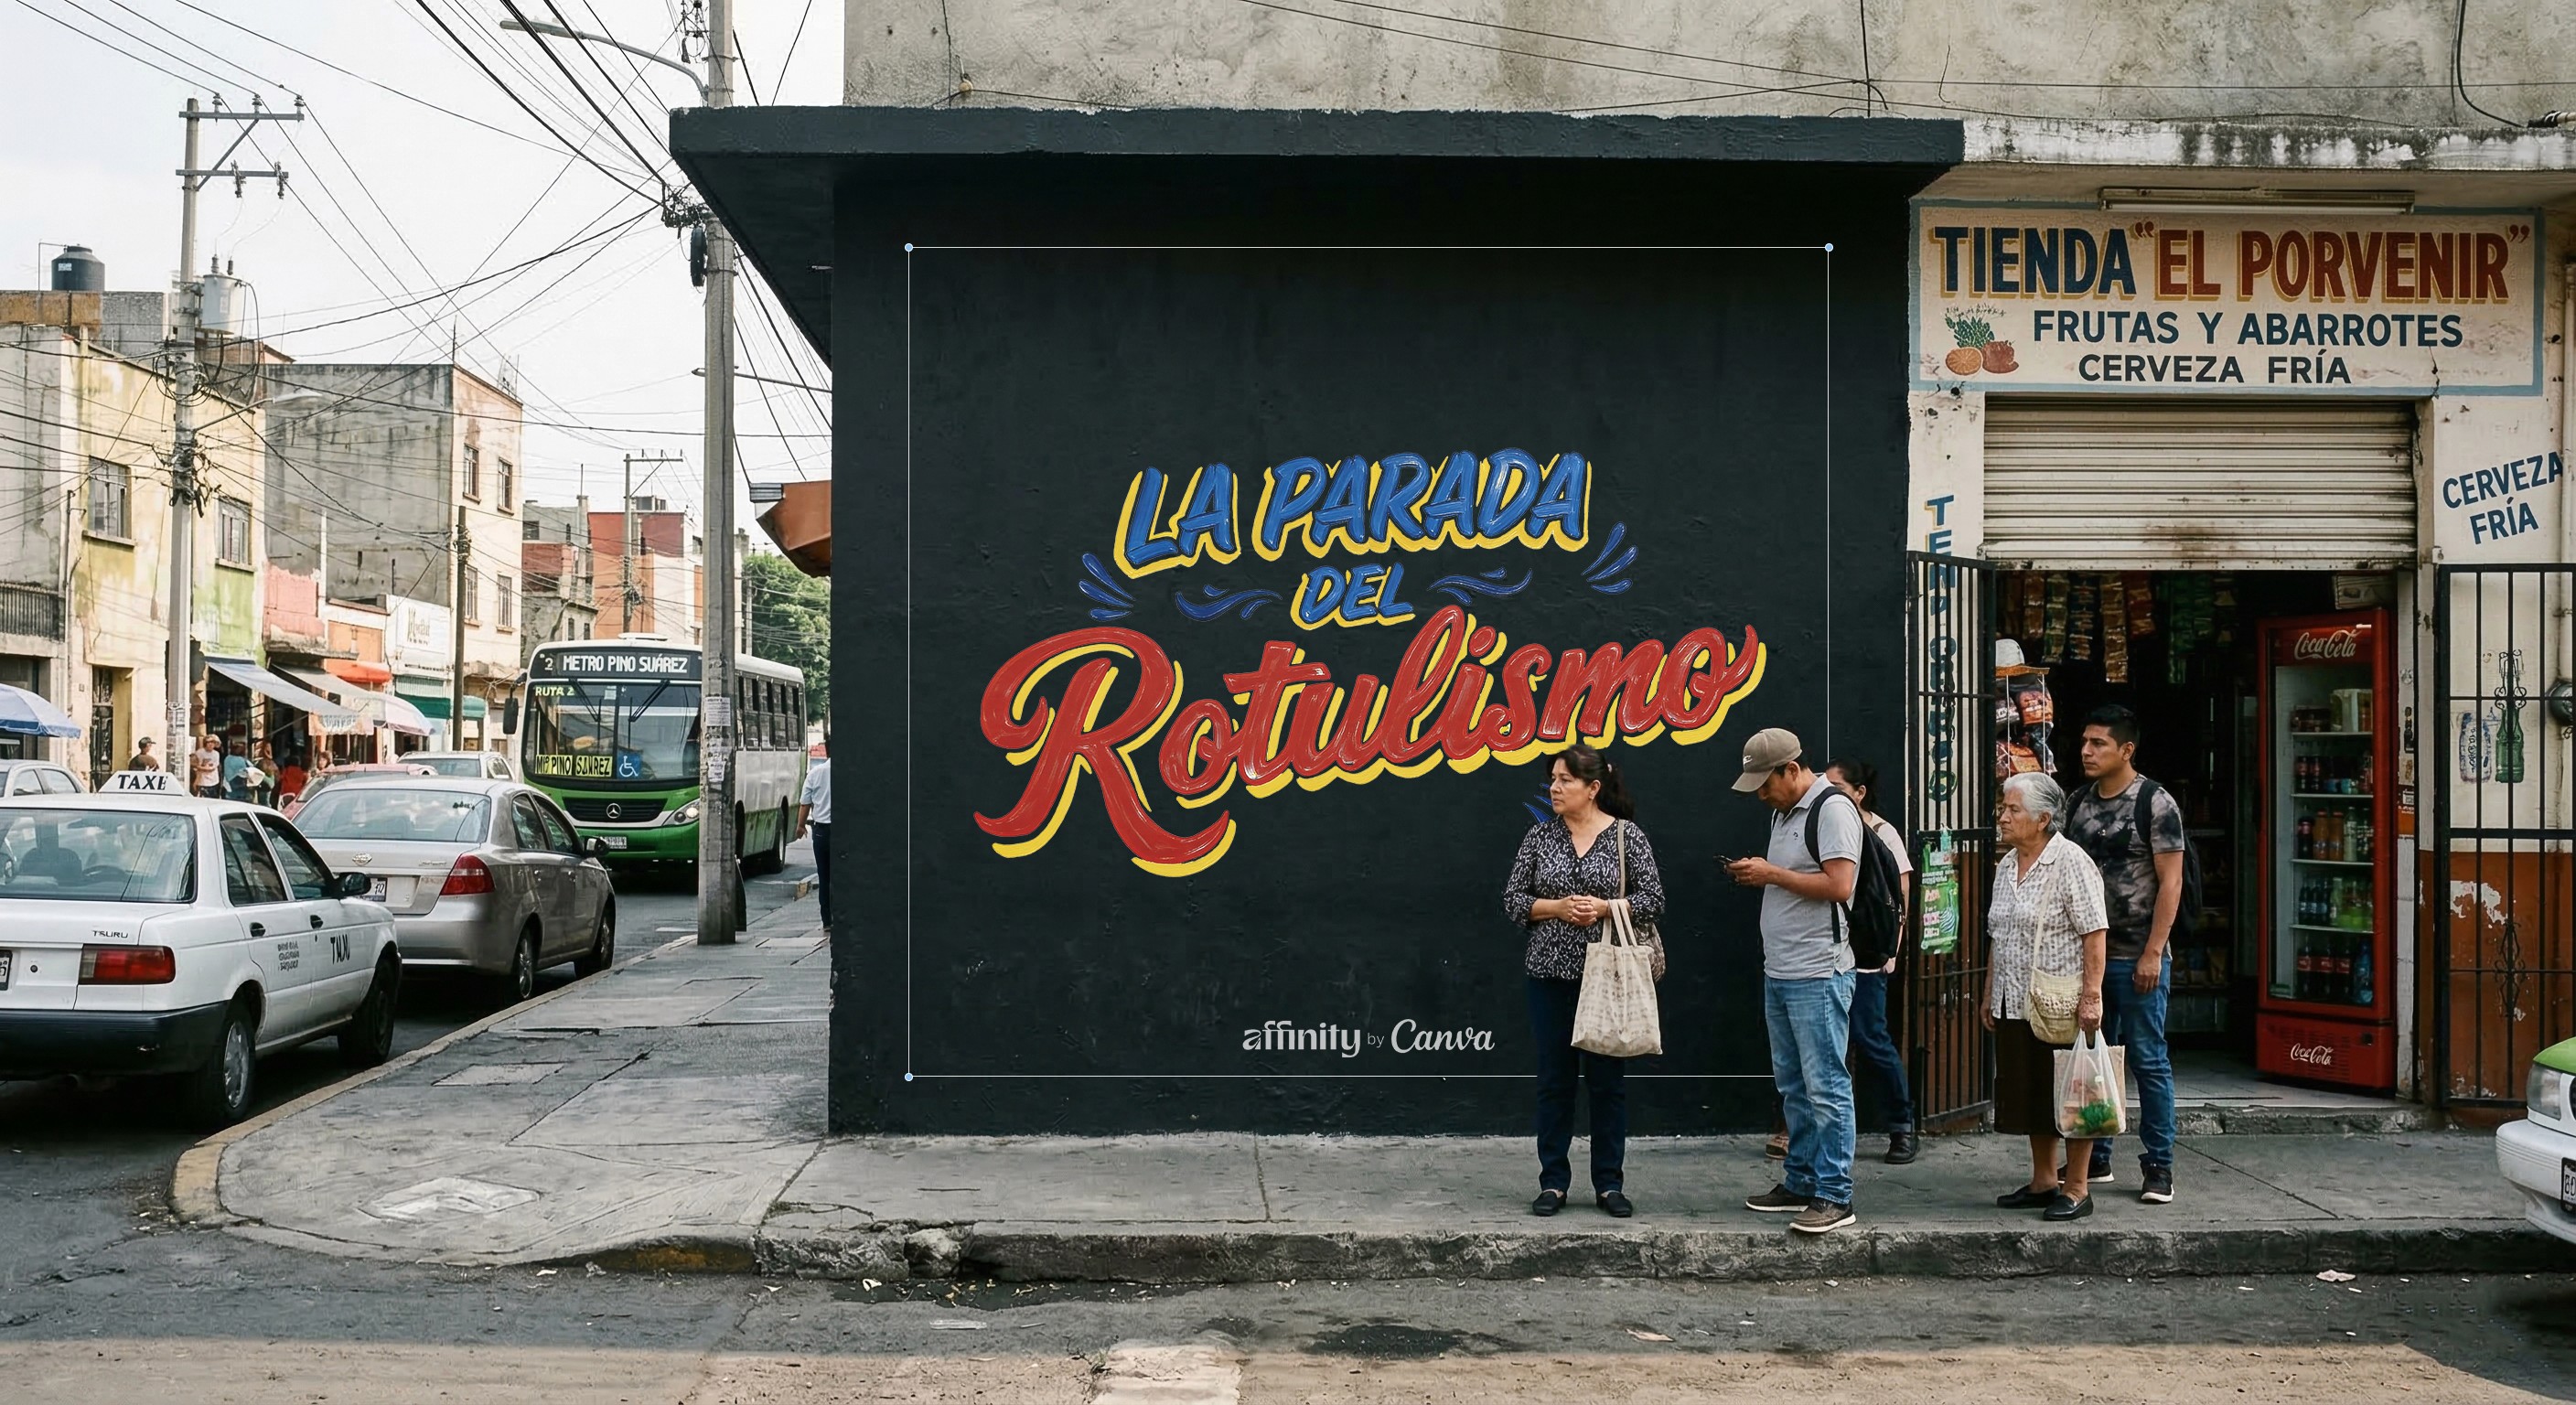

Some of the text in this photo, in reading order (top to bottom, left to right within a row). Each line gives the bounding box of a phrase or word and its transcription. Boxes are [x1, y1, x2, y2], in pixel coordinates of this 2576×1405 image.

[1929, 226, 2136, 300] TIENDA
[2033, 309, 2463, 348] FRUTAS Y ABARROTES
[2077, 349, 2352, 384] CERVEZA FRÍA
[2442, 451, 2562, 509] CERVEZA
[1114, 448, 1592, 579] LA PARADA
[2470, 497, 2538, 545] FRÍA
[1290, 562, 1416, 630] DEL
[544, 653, 688, 673] 2 METRO PINO SUÁREZ
[534, 686, 565, 697] RUTA
[973, 605, 1768, 877] Rotulismo
[551, 756, 572, 775] PINO
[91, 929, 129, 938] TSURU
